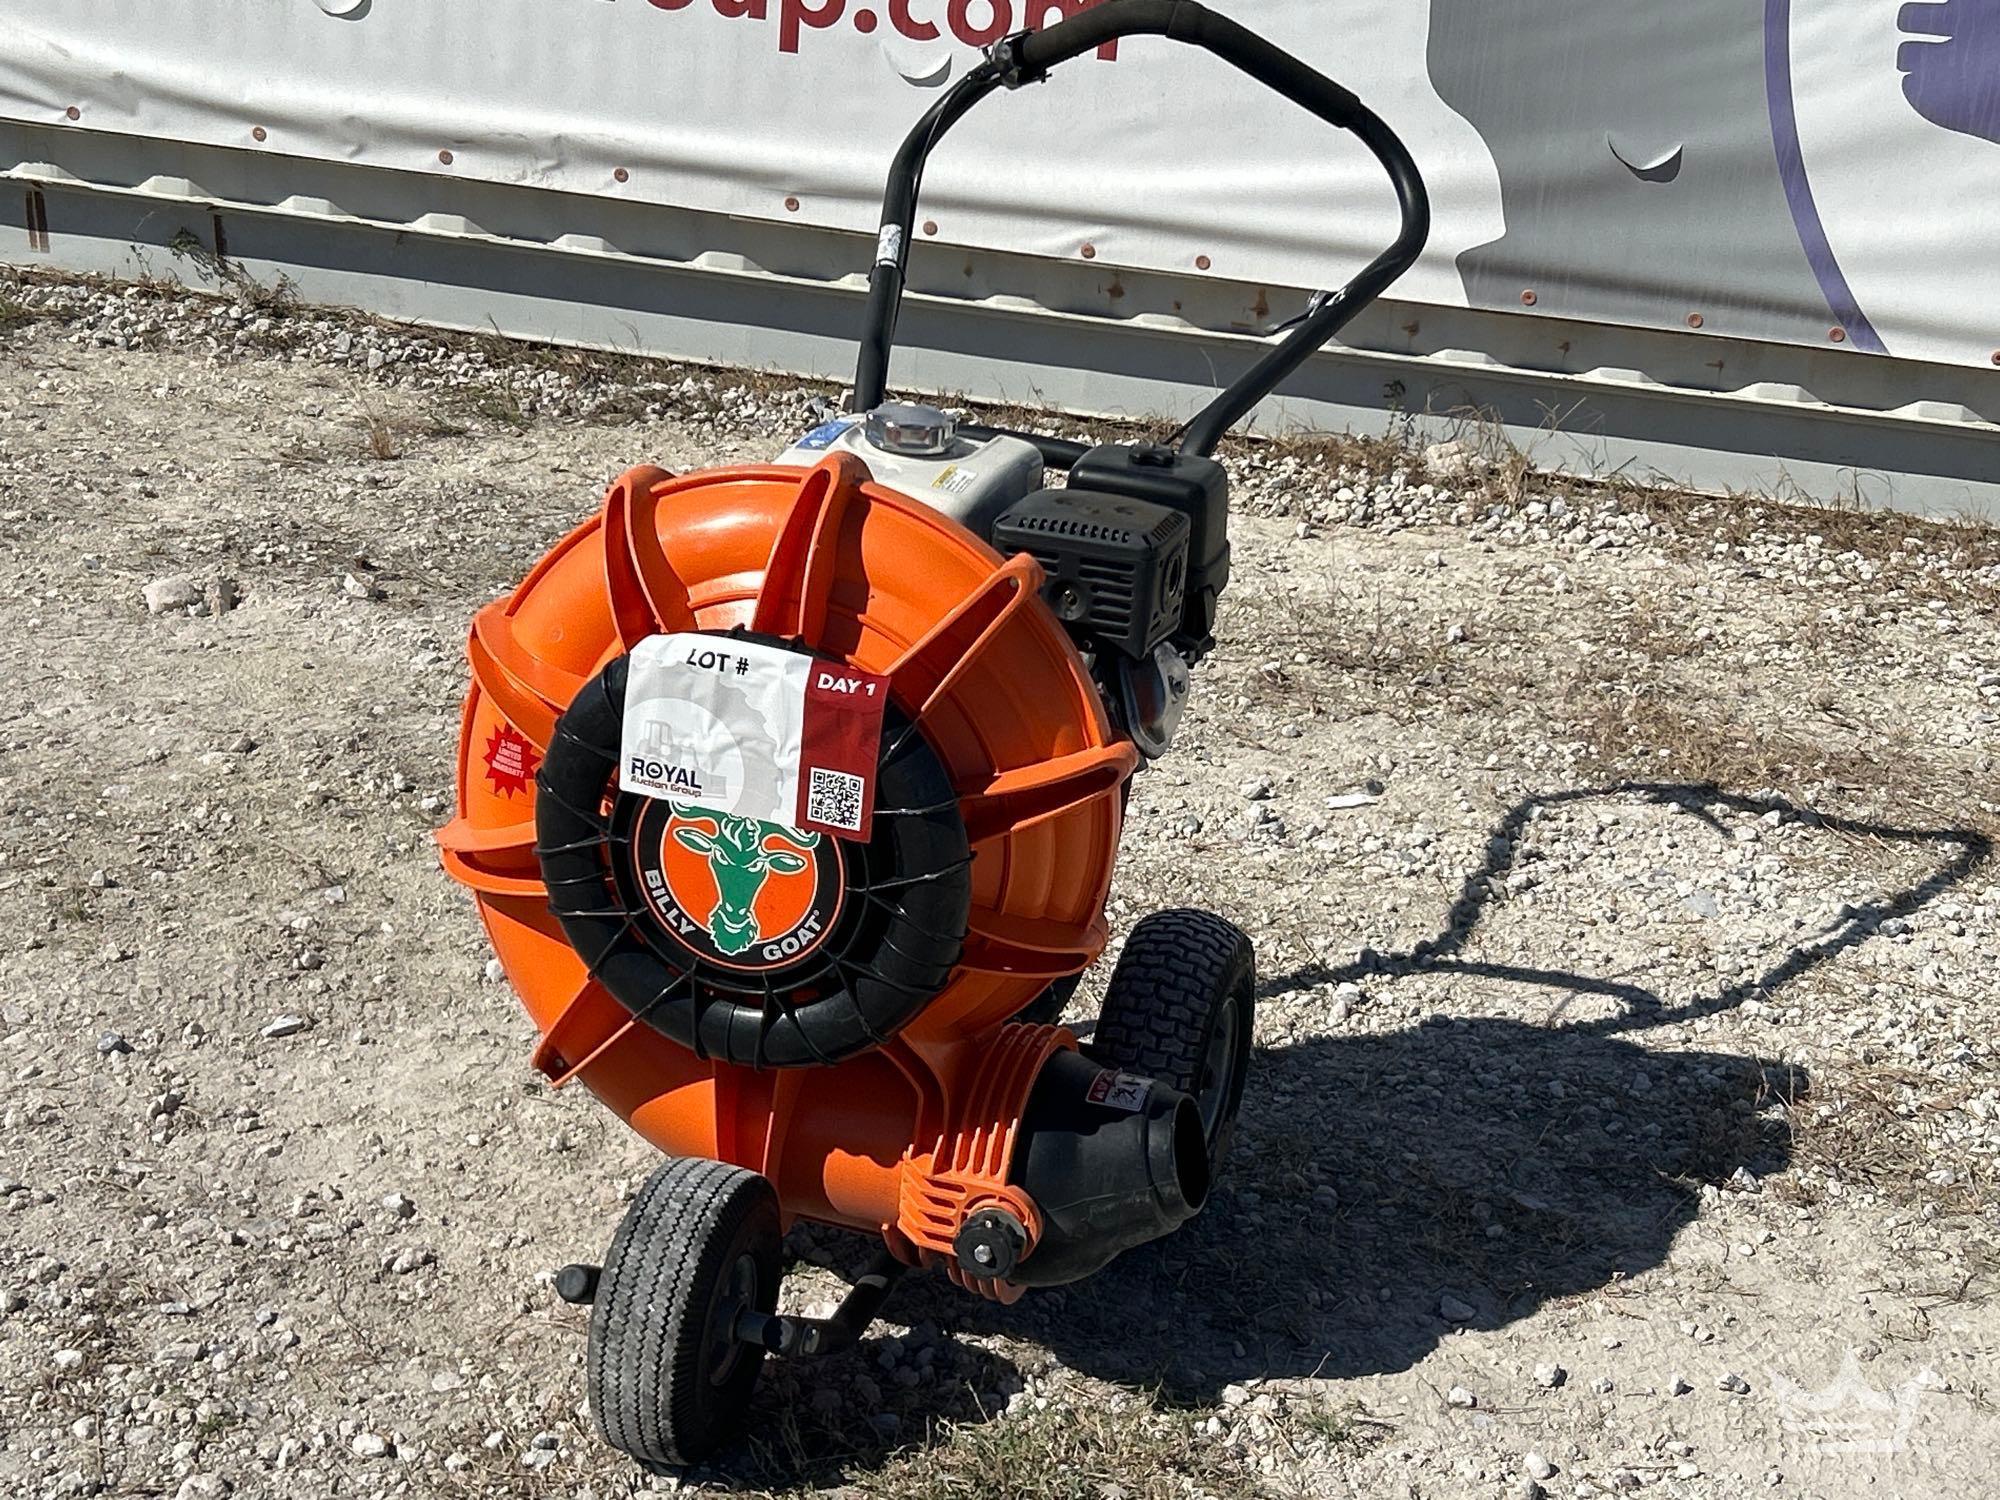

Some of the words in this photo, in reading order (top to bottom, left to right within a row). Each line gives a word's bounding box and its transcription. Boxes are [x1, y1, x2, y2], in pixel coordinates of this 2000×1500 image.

[686, 648, 731, 672] LOT
[735, 656, 750, 676] #
[817, 673, 862, 694] DAY
[865, 682, 876, 697] 1
[630, 775, 668, 790] Auction
[670, 783, 702, 798] Group
[631, 757, 702, 789] ROYAL
[644, 869, 696, 936] BILLY
[762, 918, 823, 961] GOAT
